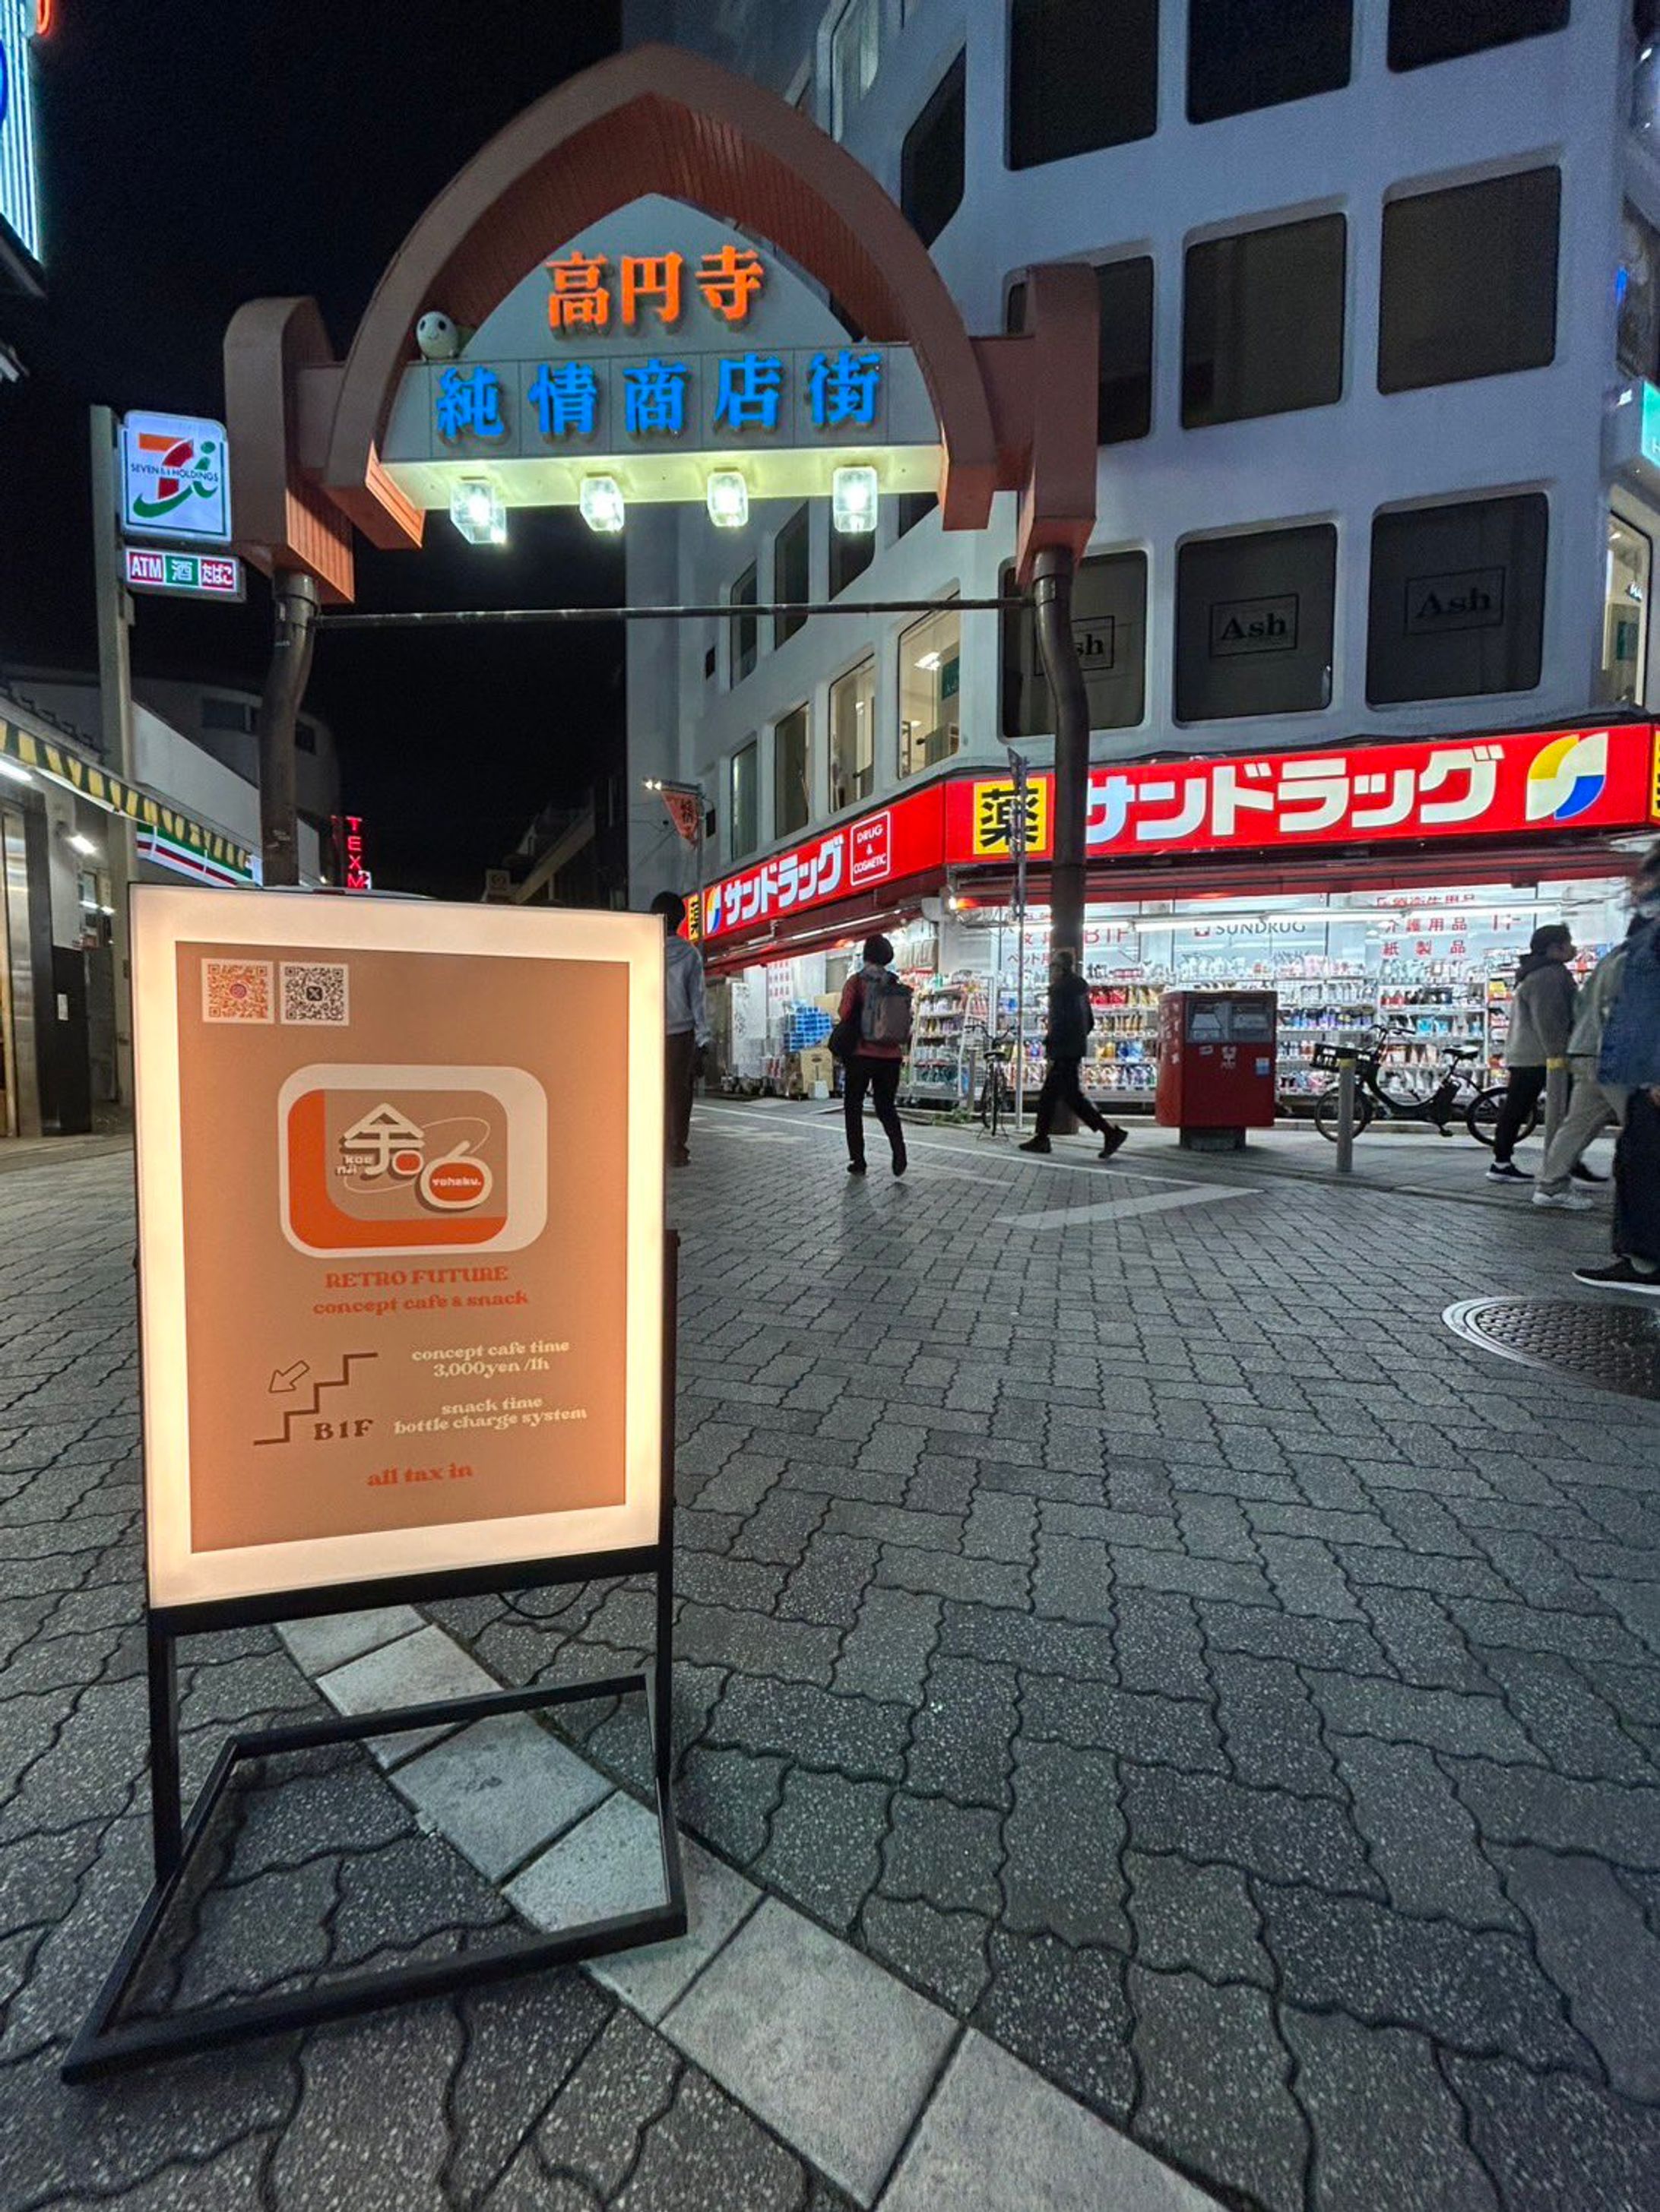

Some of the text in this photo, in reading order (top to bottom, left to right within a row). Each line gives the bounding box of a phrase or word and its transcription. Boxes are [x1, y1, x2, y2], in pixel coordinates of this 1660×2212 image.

[545, 245, 764, 328] 高円寺
[436, 351, 882, 438] 純情商店街
[131, 555, 163, 581] ATM
[172, 559, 193, 581] 酒
[201, 562, 233, 586] たばこ
[1415, 586, 1491, 619] Ash
[1221, 612, 1287, 641] Ash
[1072, 634, 1105, 657] sh
[1085, 744, 1505, 845] サンドラッグ
[980, 786, 1039, 848] 薬
[857, 824, 883, 844] DRUG
[854, 853, 887, 874] COSMETIC
[724, 834, 844, 926] サンドラッグ
[1216, 914, 1306, 935] SUNDRUG
[325, 1266, 508, 1290] RETRO FUTURE
[312, 1297, 398, 1316] concept
[466, 1290, 529, 1308] snack
[412, 1345, 486, 1362] concept
[530, 1340, 570, 1354] time
[433, 1360, 521, 1379] 3,000yen
[442, 1396, 543, 1416] snack time
[314, 1418, 374, 1441] B1F
[394, 1407, 588, 1435] bottle charge system
[367, 1462, 474, 1487] all tax in
